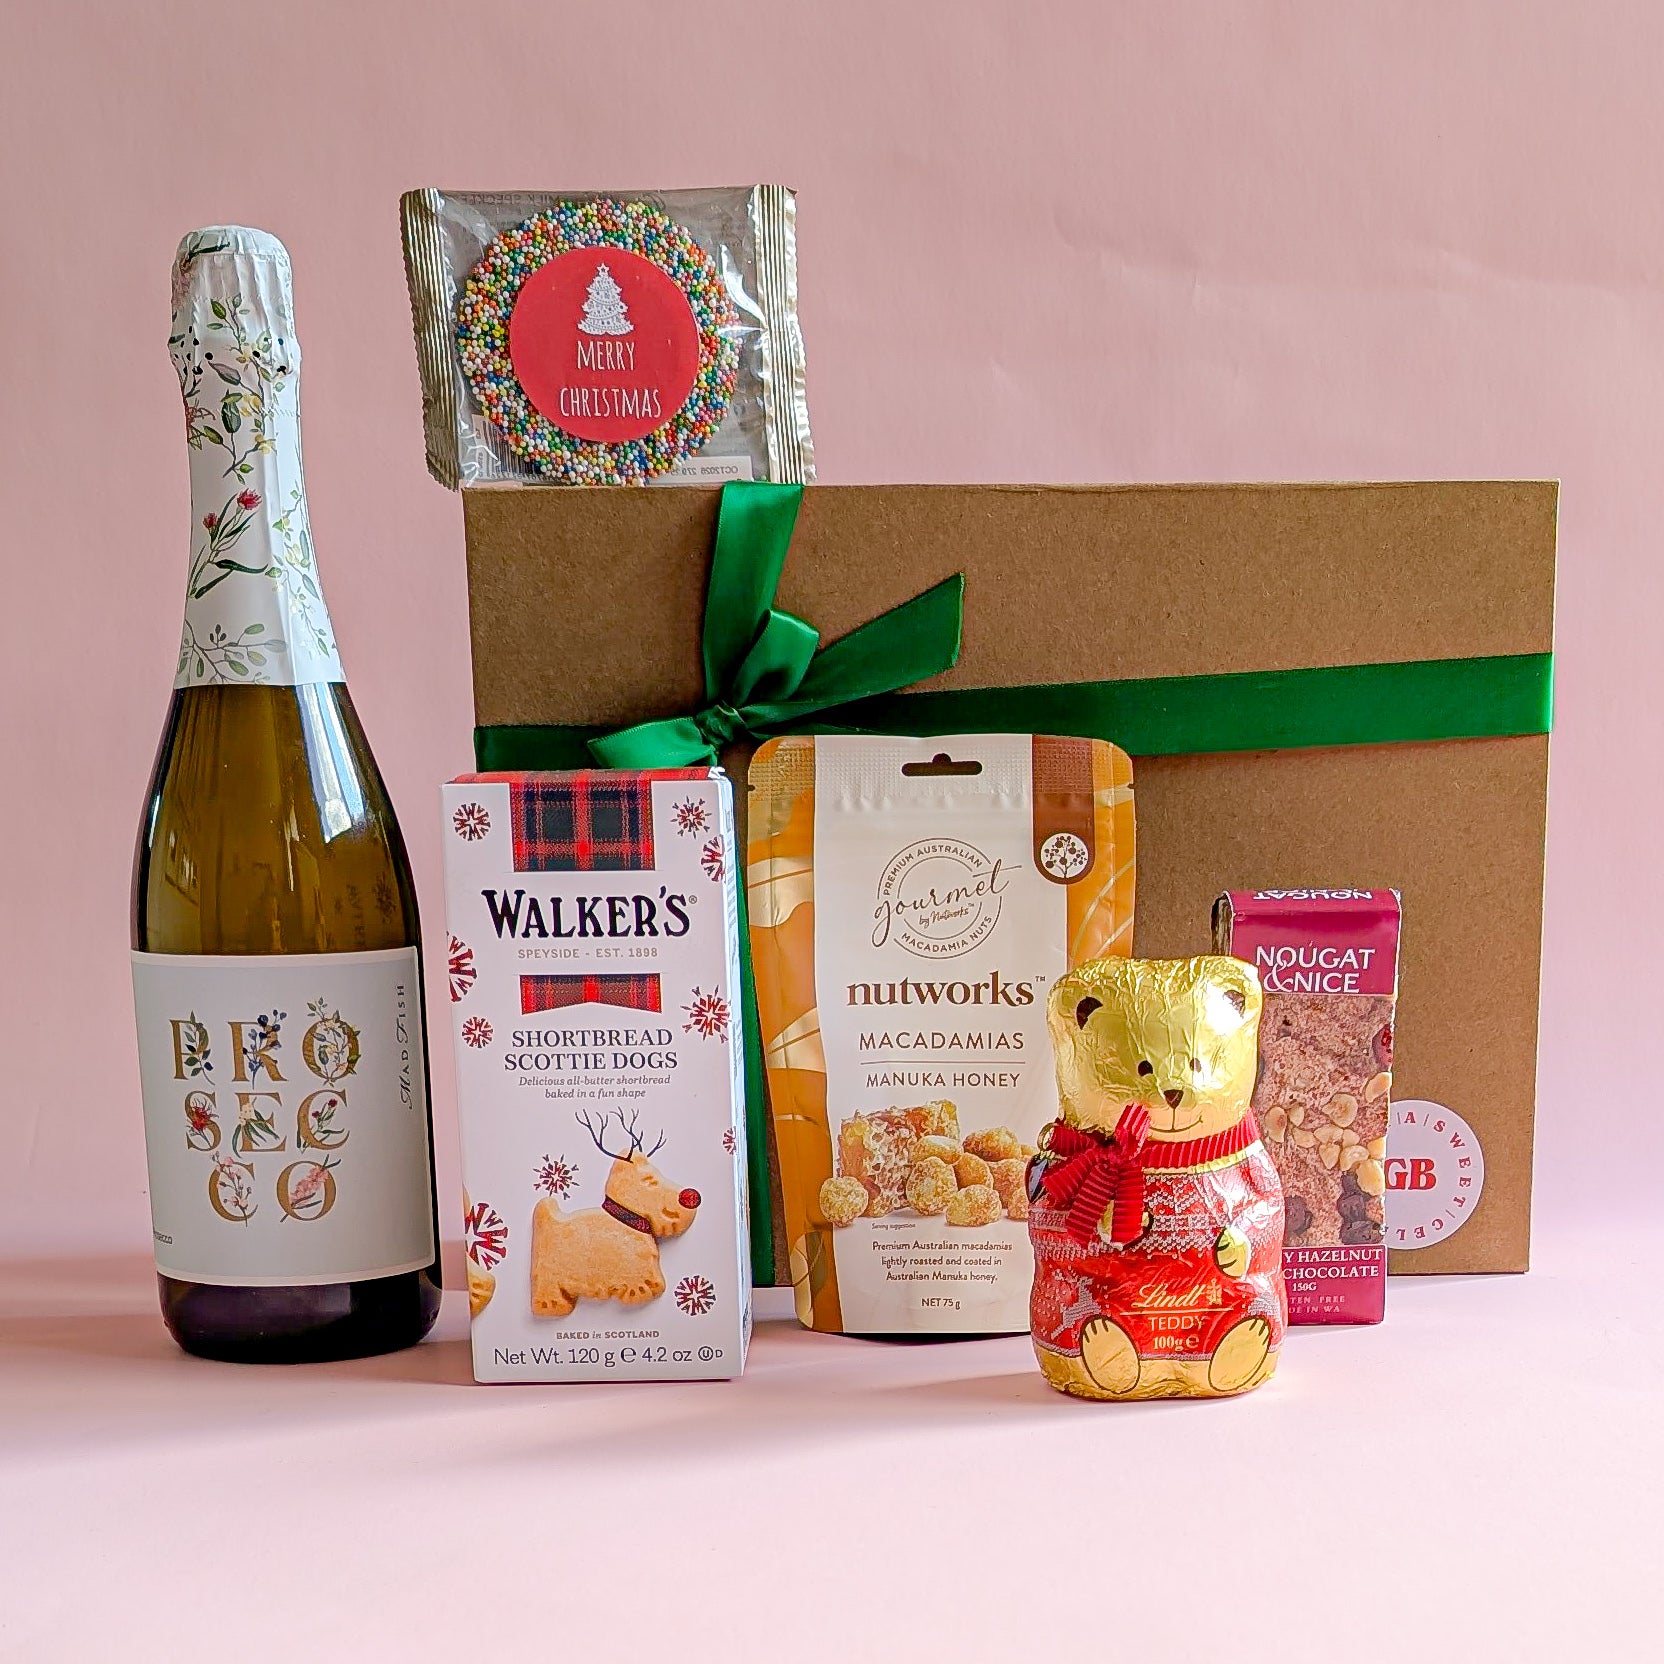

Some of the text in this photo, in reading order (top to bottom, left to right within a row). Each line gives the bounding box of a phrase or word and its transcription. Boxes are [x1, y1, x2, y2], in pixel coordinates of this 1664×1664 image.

[577, 340, 636, 372] MERRY
[559, 388, 662, 418] CHRISTMAS
[883, 845, 982, 896] PREMIUM AUSTRALIAN
[871, 858, 1022, 948] gourmet
[901, 915, 992, 953] MACADAMIA NUTS
[518, 948, 580, 959] SPEYSIDE
[595, 948, 624, 958] EST.
[628, 947, 658, 958] 1898
[511, 1028, 673, 1048] SHORTBREAD
[859, 1031, 1025, 1050] MACADAMIAS
[504, 1051, 678, 1071] SCOTTIE DOGS
[519, 1074, 671, 1086] Delicious all-butter shortbread
[866, 1072, 1021, 1088] MANUKA HONEY
[545, 1088, 574, 1098] baked
[577, 1089, 587, 1098] in
[598, 1088, 614, 1099] fun
[616, 1088, 646, 1099] shape
[872, 1240, 1013, 1251] Premium Australian macadamias
[881, 1255, 1002, 1269] lightly roasted and coated in
[1297, 1248, 1383, 1263] HAZELNUT
[886, 1270, 998, 1284] Australian Manuka honey.
[1283, 1265, 1380, 1280] CHOCOLATE
[921, 1298, 941, 1307] NET
[943, 1298, 954, 1307] 75
[1131, 1282, 1207, 1308] Lindt
[1319, 1295, 1346, 1303] FREE
[1306, 1306, 1319, 1314] IN
[1323, 1305, 1341, 1313] WA
[1147, 1315, 1205, 1331] TEDDY
[556, 1330, 660, 1340] BAKED in SCOTLAND
[1153, 1335, 1184, 1351] 100g
[494, 1348, 526, 1365] Net
[530, 1347, 564, 1364] Wt.
[568, 1347, 600, 1364] 120
[604, 1350, 616, 1367] g
[641, 1346, 668, 1363] 4.2
[672, 1350, 692, 1362] oz
